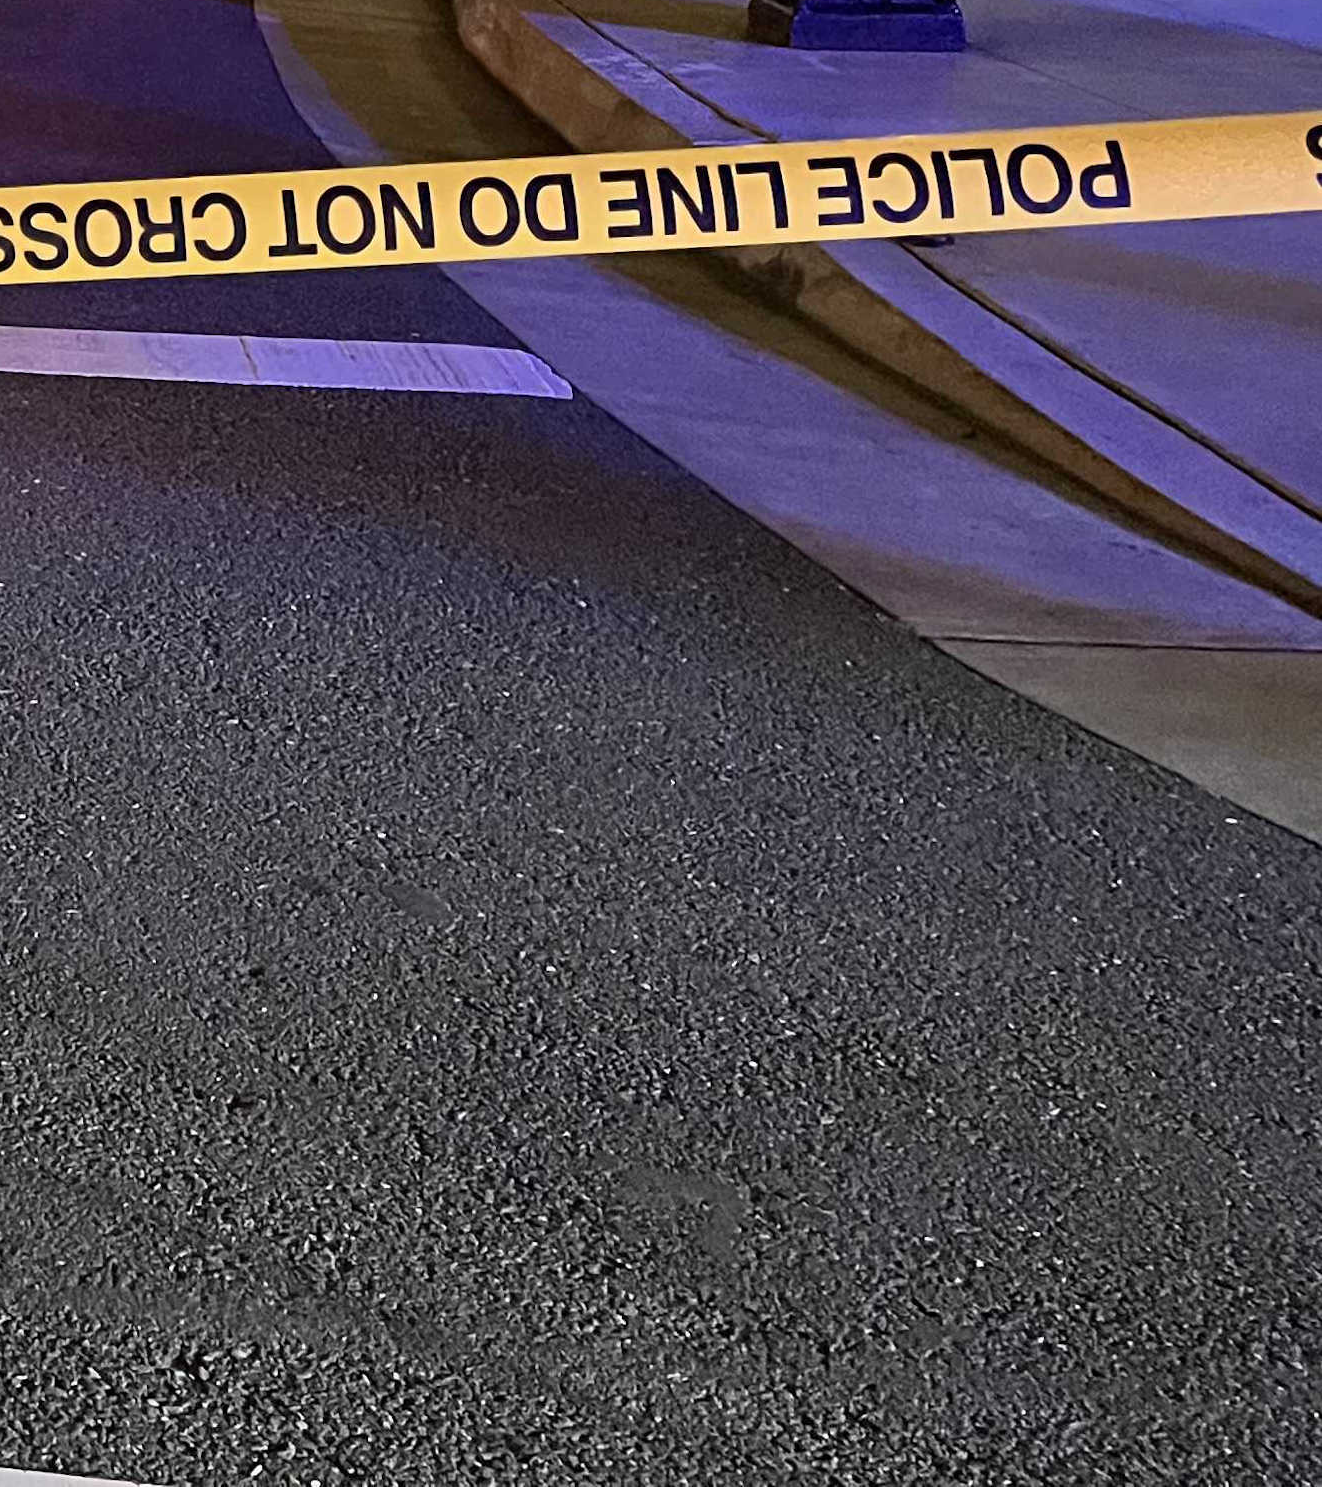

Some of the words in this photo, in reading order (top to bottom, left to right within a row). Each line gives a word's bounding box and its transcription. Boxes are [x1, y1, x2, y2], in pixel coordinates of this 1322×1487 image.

[269, 182, 434, 257] NOT
[460, 174, 578, 246] DO
[600, 161, 788, 238] LINE
[808, 141, 1131, 226] POLICE
